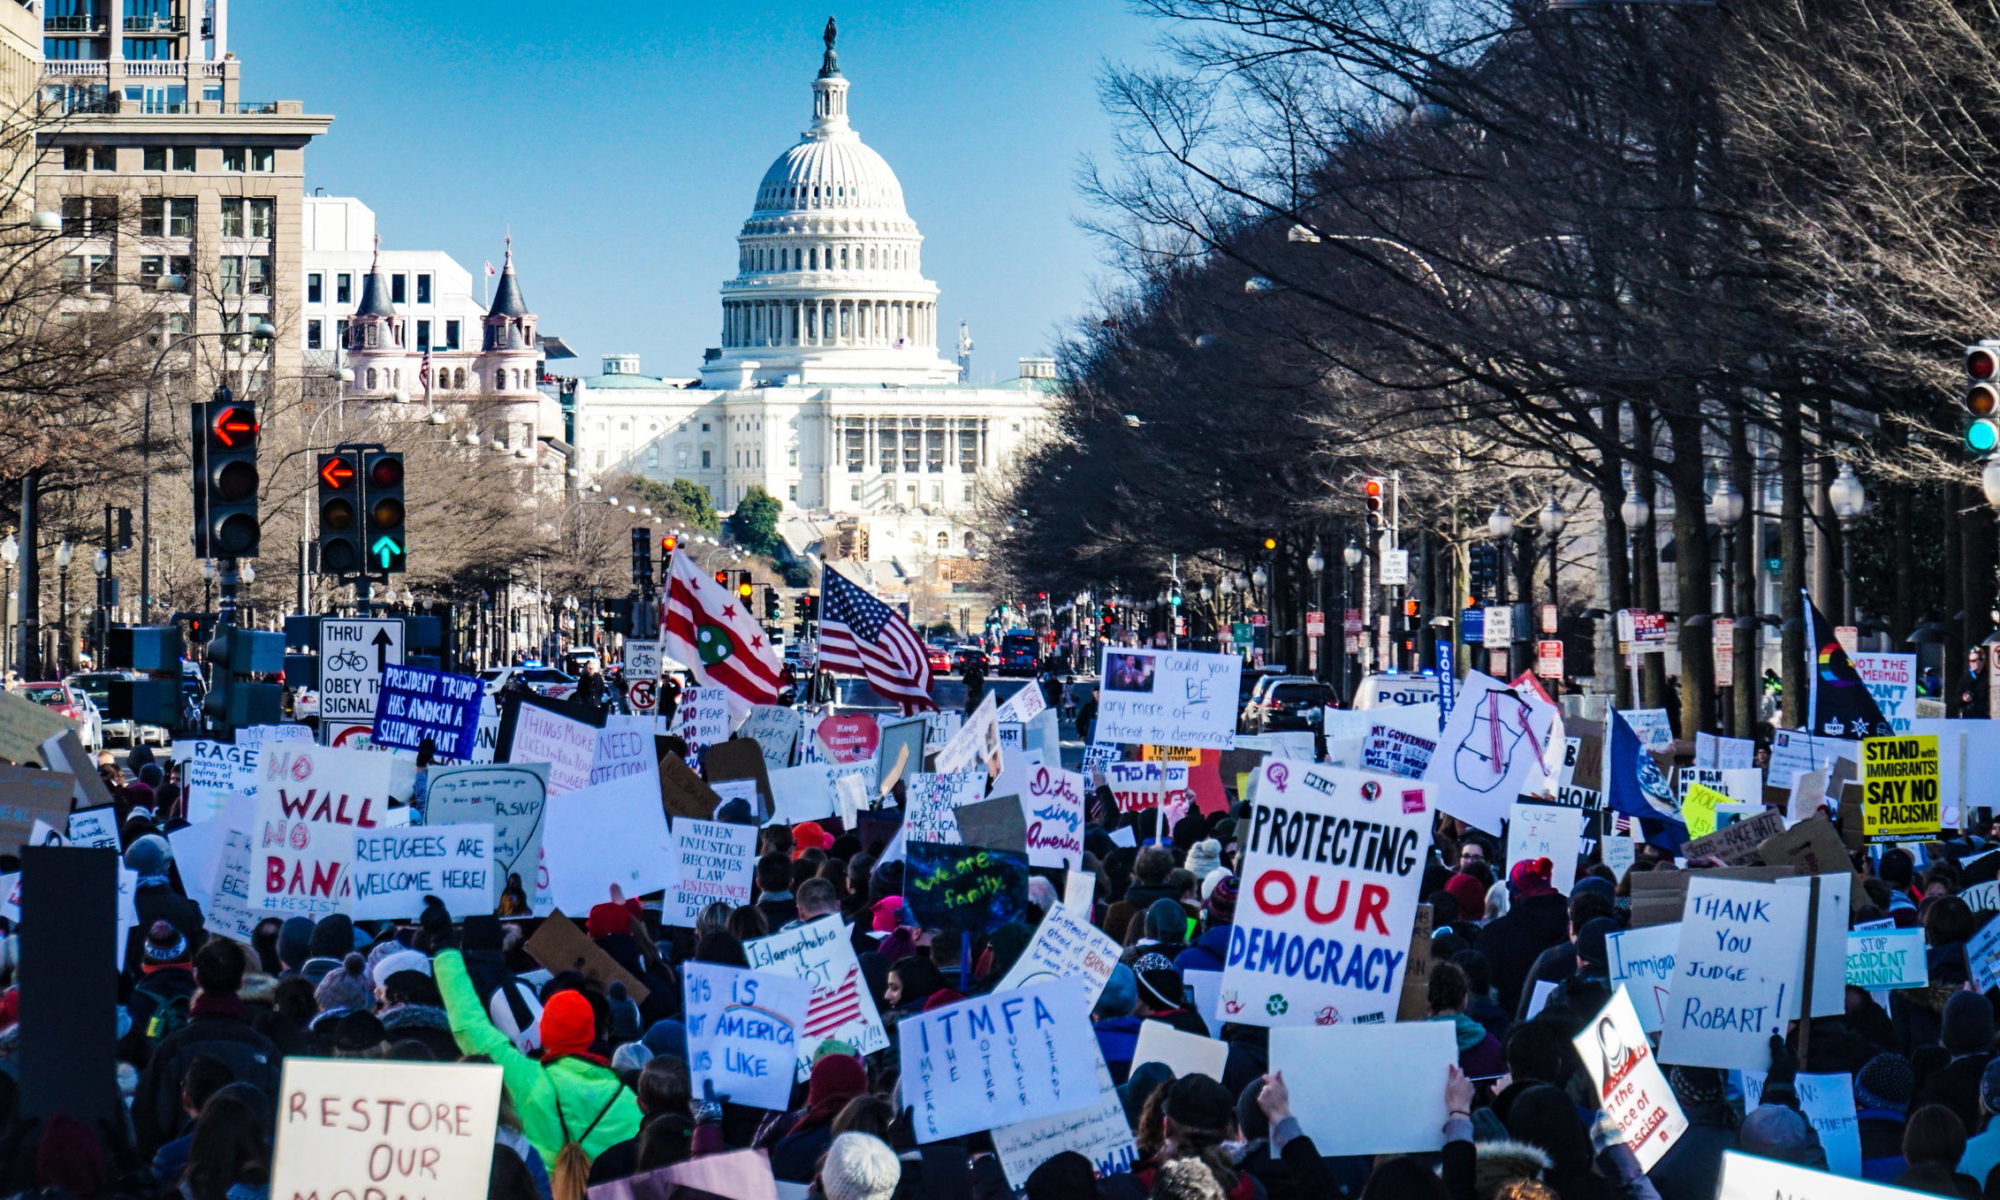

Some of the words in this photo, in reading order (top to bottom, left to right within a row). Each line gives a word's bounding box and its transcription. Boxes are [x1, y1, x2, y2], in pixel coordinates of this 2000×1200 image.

[326, 626, 363, 642] THRU
[1164, 655, 1200, 672] Could
[1208, 662, 1230, 678] you
[1881, 660, 1909, 670] THE
[325, 678, 361, 694] OBEY
[368, 679, 382, 694] TH
[385, 667, 436, 694] PRESIDENT
[442, 677, 477, 701] TRUMP
[1185, 677, 1212, 699] BE
[1862, 671, 1909, 684] MERMAID
[324, 698, 375, 714] SIGNAL
[682, 689, 697, 705] NO
[701, 689, 725, 700] HATE
[388, 694, 405, 716] HAS
[408, 698, 453, 724] AWOKEN
[454, 706, 463, 727] A
[682, 707, 697, 723] NO
[700, 708, 724, 721] FEAR
[1104, 701, 1127, 718] any
[1132, 702, 1165, 717] more
[1173, 707, 1192, 720] of
[1202, 709, 1210, 720] a
[379, 719, 422, 747] SLEEPING
[522, 706, 561, 740] THINGS
[565, 724, 595, 752] MORE
[683, 726, 697, 740] NO
[700, 725, 720, 736] BAN
[837, 725, 859, 733] Keep
[1105, 721, 1143, 738] threat
[1150, 725, 1165, 740] to
[1371, 725, 1386, 737] MY
[1387, 729, 1437, 753] GOVERNMENT
[600, 732, 642, 761] NEED
[830, 736, 867, 745] Families
[1867, 740, 1919, 761] STAND
[1921, 748, 1937, 758] with
[195, 742, 259, 767] RAGE
[834, 749, 855, 758] oget
[1365, 749, 1381, 757] BUT
[1366, 758, 1389, 769] WILL
[192, 768, 217, 780] dying
[222, 772, 232, 780] of
[194, 760, 232, 771] against
[267, 752, 314, 782] NO
[1681, 770, 1695, 780] NO
[1700, 770, 1722, 782] BAN
[1867, 761, 1938, 778] IMMIGRANTS!
[919, 773, 970, 784] SUDANESE
[925, 783, 963, 794] SOMALI
[1304, 773, 1336, 795] #BLM
[1868, 780, 1906, 805] SAY
[1911, 779, 1937, 803] NO
[278, 788, 377, 829] WALL
[1033, 804, 1082, 833] sing
[1521, 809, 1557, 824] CUZ
[1867, 815, 1877, 825] to
[1880, 804, 1938, 824] RACISM!
[263, 820, 311, 851] NO
[693, 823, 733, 839] WHEN
[1250, 804, 1419, 877] PROTECTING
[1528, 826, 1538, 837] I
[357, 836, 446, 862] REFUGEES
[457, 839, 484, 859] ARE
[680, 835, 747, 857] INJUSTICE
[682, 853, 743, 872] BECOMES
[956, 851, 992, 875] are
[266, 856, 341, 898] BAN
[355, 871, 433, 901] WELCOME
[442, 870, 487, 890] HERE!
[696, 868, 726, 882] LAW
[1253, 869, 1391, 937] OUR
[1693, 894, 1770, 923] THANK
[1050, 905, 1090, 940] Instead
[748, 929, 836, 969] Islamophobia
[1716, 928, 1751, 953] YOU
[1861, 937, 1888, 952] STOP
[1227, 924, 1405, 994] DEMOCRACY
[1609, 933, 1677, 981] Immigra
[1846, 950, 1908, 969] RESIDENT
[1685, 961, 1750, 982] JUDGE
[920, 996, 1056, 1054] ITMFA
[1357, 1011, 1385, 1024] BELIEVE
[714, 1014, 795, 1046] AMERICA
[725, 1048, 768, 1078] LIKE
[1615, 1082, 1634, 1106] the
[289, 1091, 473, 1137] RESTORE
[1618, 1108, 1638, 1134] ace
[1637, 1090, 1651, 1111] of
[1627, 1106, 1667, 1153] ascism
[368, 1143, 441, 1182] OUR
